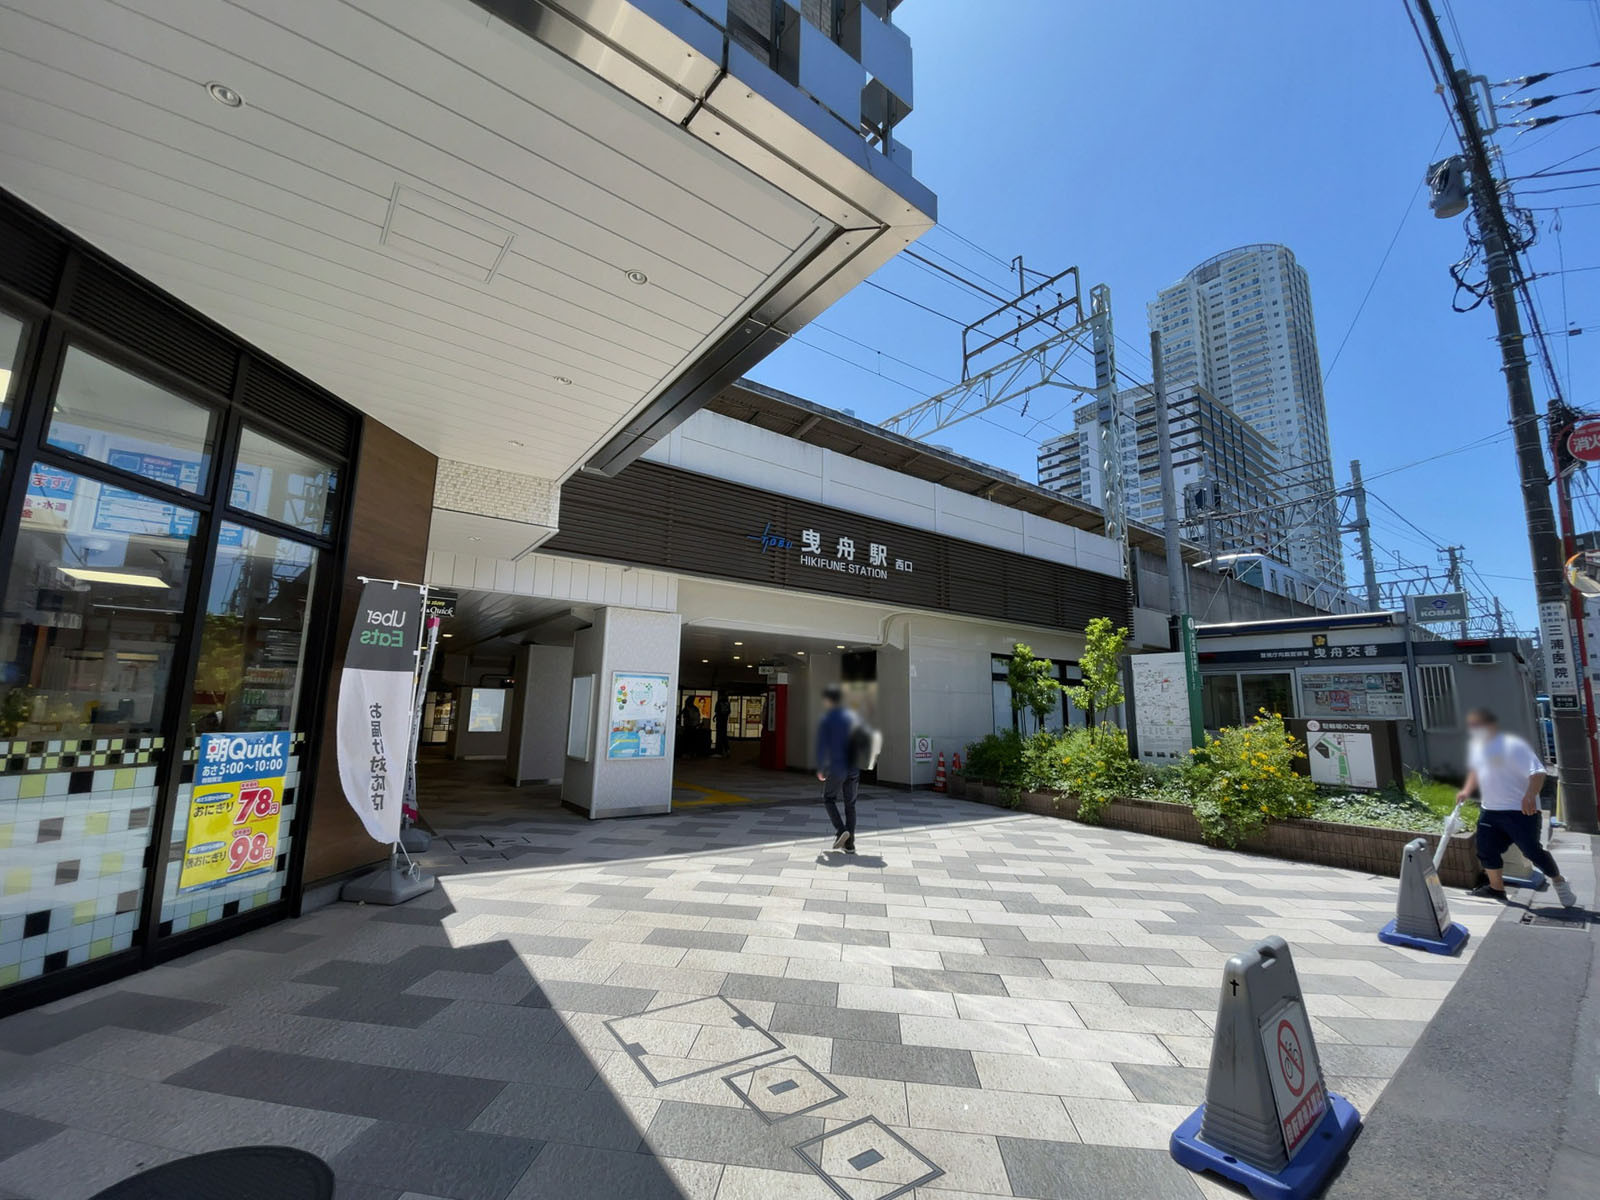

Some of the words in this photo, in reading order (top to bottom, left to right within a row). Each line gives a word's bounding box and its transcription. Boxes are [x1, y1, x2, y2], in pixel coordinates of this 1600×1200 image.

[801, 528, 888, 567] 曳舟駅
[895, 558, 913, 573] 西口
[800, 555, 846, 572] HIKIFUNE
[848, 563, 888, 580] STATION
[1420, 608, 1461, 617] KOBAN
[1314, 645, 1378, 659] 曳舟交番
[1548, 624, 1569, 679] 三浦医院
[193, 802, 234, 817] おにぎり
